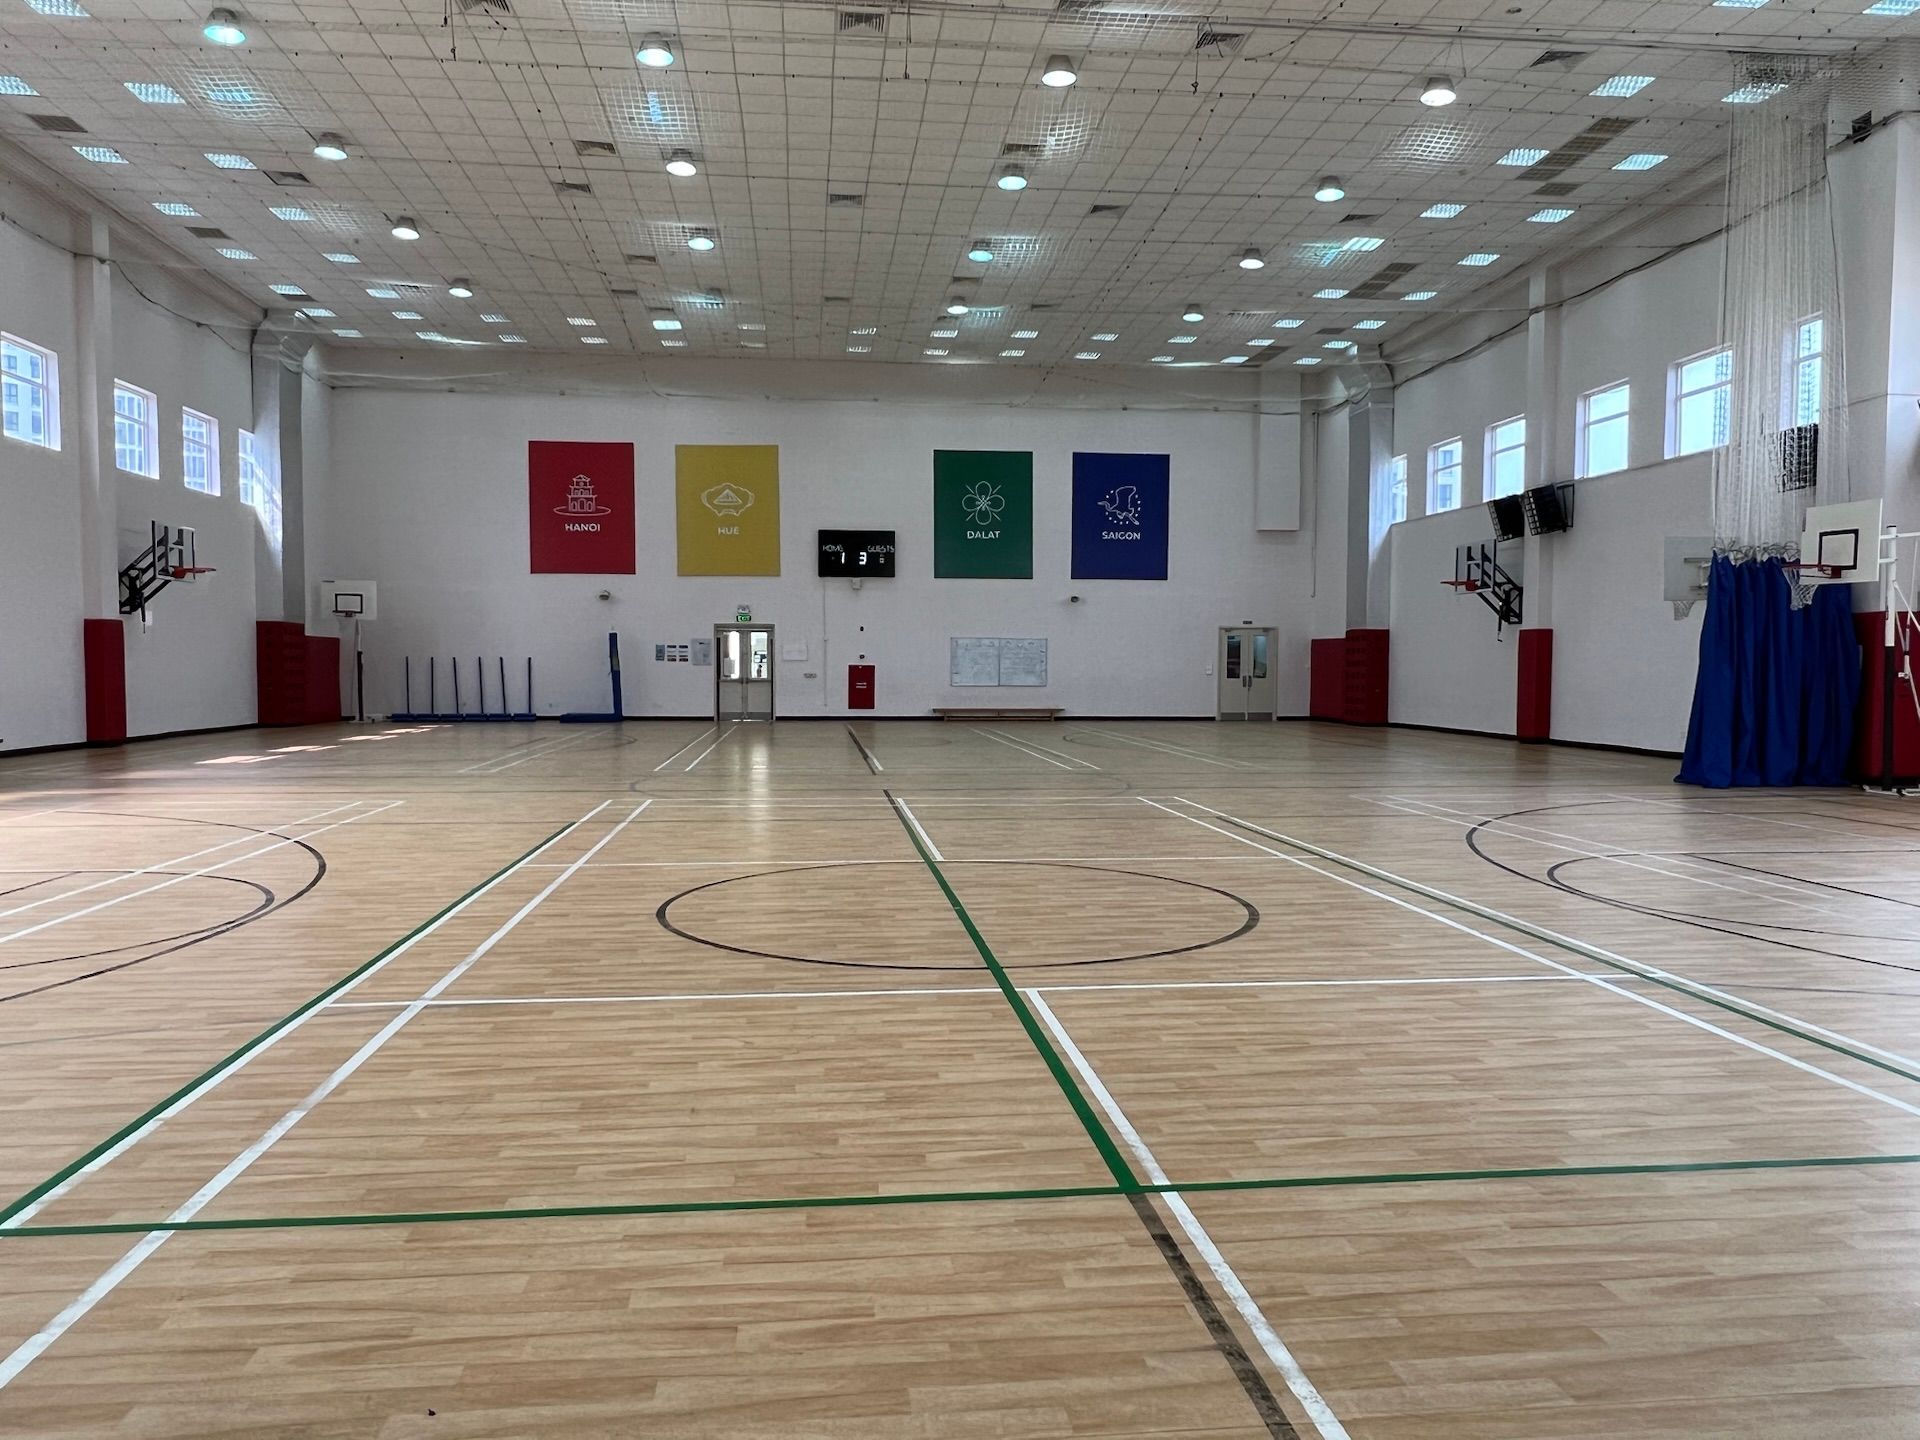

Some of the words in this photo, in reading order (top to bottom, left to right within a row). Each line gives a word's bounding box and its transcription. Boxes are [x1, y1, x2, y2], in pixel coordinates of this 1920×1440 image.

[565, 523, 601, 532] HANOI
[717, 527, 740, 535] HUE
[967, 530, 1001, 539] DALAT
[1102, 531, 1141, 540] SAIGON
[859, 552, 867, 565] 3
